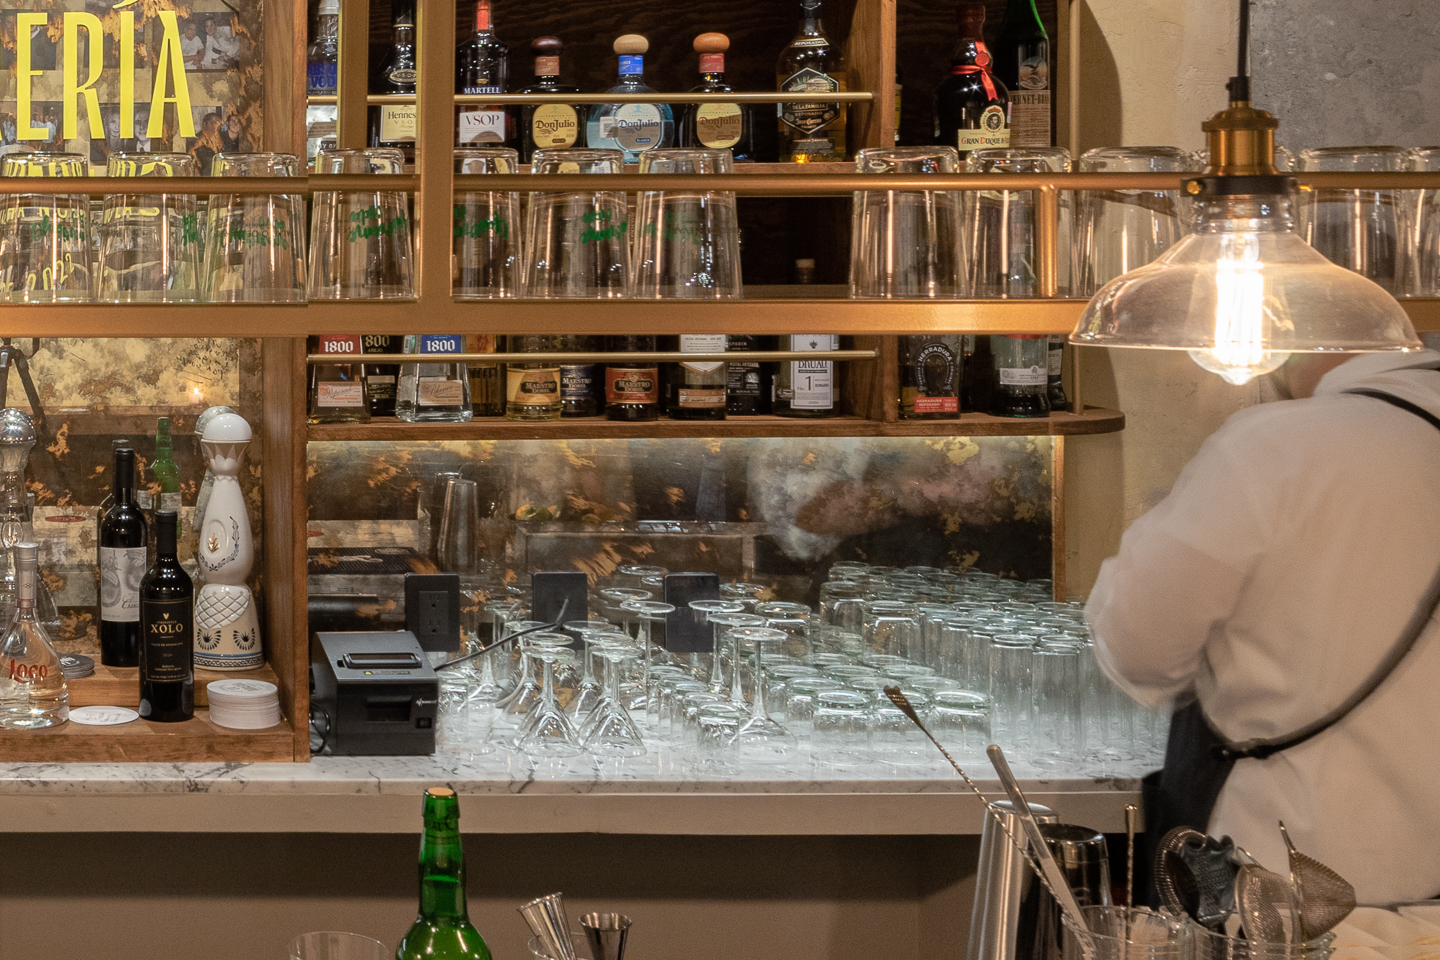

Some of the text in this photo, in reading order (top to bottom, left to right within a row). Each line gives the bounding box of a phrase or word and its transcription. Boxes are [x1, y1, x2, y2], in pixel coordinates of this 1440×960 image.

[464, 86, 500, 94] MARTELL
[465, 114, 500, 125] VSOP
[961, 137, 979, 145] GRAN
[980, 137, 1001, 145] DUQUE
[324, 341, 354, 352] 1800
[426, 340, 456, 352] 1800
[918, 346, 953, 362] HERRADURA
[150, 623, 183, 634] XOLO
